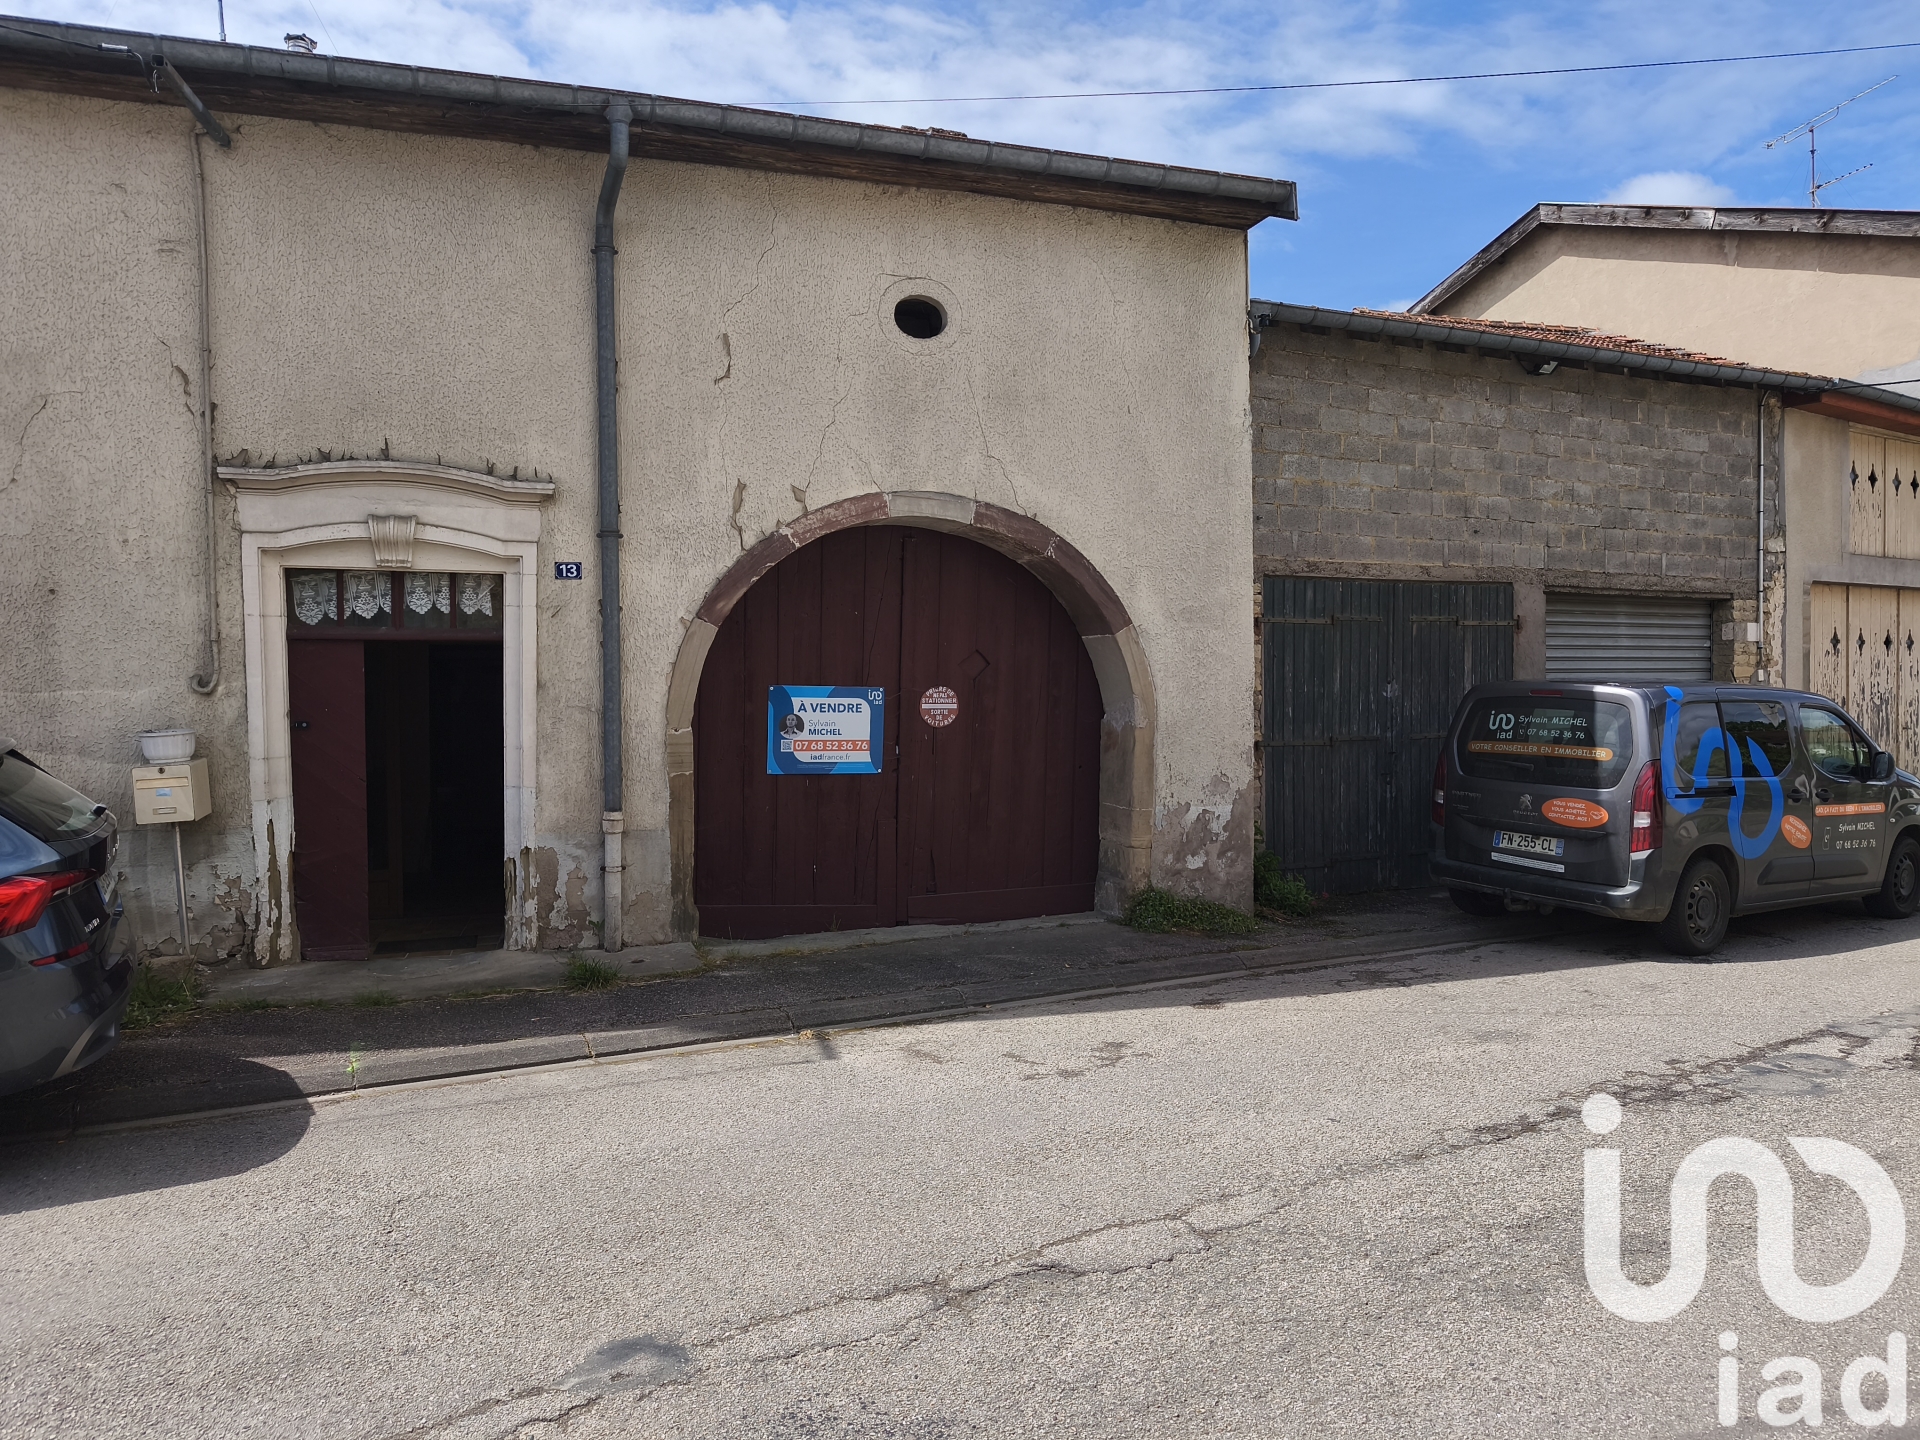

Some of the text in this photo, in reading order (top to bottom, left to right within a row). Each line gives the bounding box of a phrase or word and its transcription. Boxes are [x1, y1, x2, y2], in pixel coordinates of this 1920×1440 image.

[560, 564, 577, 577] 13
[798, 701, 862, 713] À VENDRE
[808, 720, 836, 728] Sylvain
[925, 714, 955, 726] VOITURES
[1519, 715, 1588, 727] Sylvain MICHEL
[1497, 730, 1513, 739] iad
[796, 742, 868, 750] 07 68 52 36 76
[1494, 744, 1537, 753] CONSEILLER
[1554, 748, 1606, 758] IMMOBILIER
[1839, 822, 1875, 833] Sylvain MICHEL
[1501, 833, 1554, 852] FN-255-CL
[1836, 841, 1843, 849] 07
